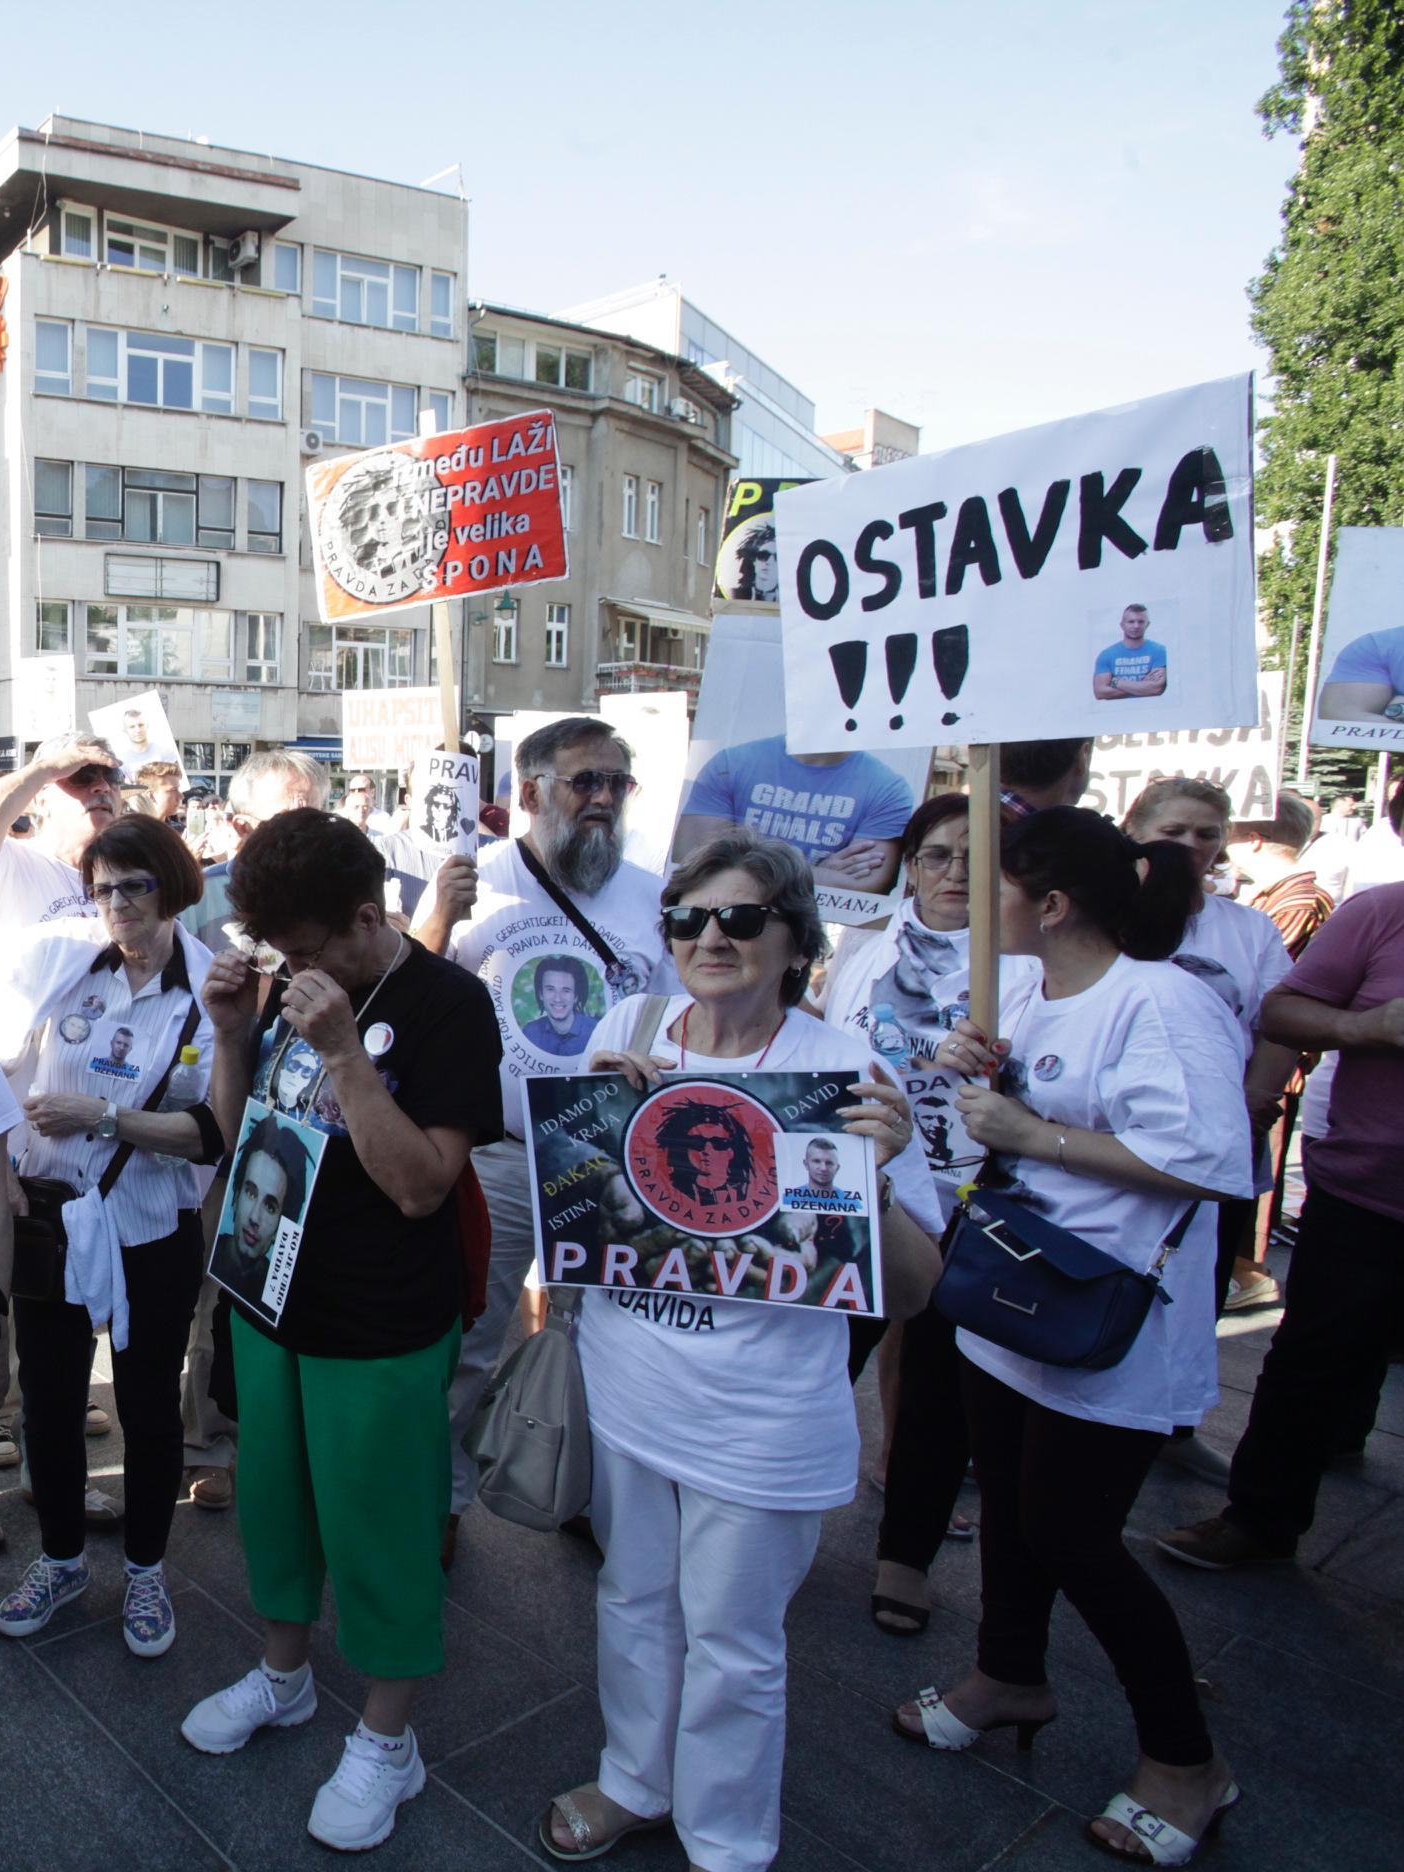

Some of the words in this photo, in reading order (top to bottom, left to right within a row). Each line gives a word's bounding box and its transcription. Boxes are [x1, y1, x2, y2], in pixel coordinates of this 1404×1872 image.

[491, 420, 554, 463] LAŽI
[409, 464, 555, 519] NEPRAVDE
[425, 527, 448, 559] je
[454, 512, 530, 546] velika
[796, 445, 1234, 621] OSTAVKA
[326, 541, 376, 596] PRAVDA
[386, 581, 409, 595] ZA
[751, 783, 855, 818] GRAND
[746, 807, 845, 846] FINALS
[816, 893, 880, 914] ENANA
[507, 934, 548, 958] PRAVDA
[553, 934, 568, 944] ZA
[494, 976, 502, 1012] DAVID
[540, 1098, 593, 1136] IDAMO
[593, 1082, 618, 1104] DO
[782, 1082, 840, 1121] DAVID
[568, 1113, 621, 1147] KRAJA
[635, 1157, 694, 1221] PRAVDA
[706, 1212, 732, 1225] ZA
[784, 1188, 839, 1200] PRAVDA
[843, 1190, 862, 1201] ZA
[548, 1198, 597, 1231] ISTINA
[272, 1231, 288, 1281] DAVIDA
[290, 1230, 300, 1251] KO
[285, 1253, 294, 1271] JE
[549, 1241, 868, 1312] PRAVDA
